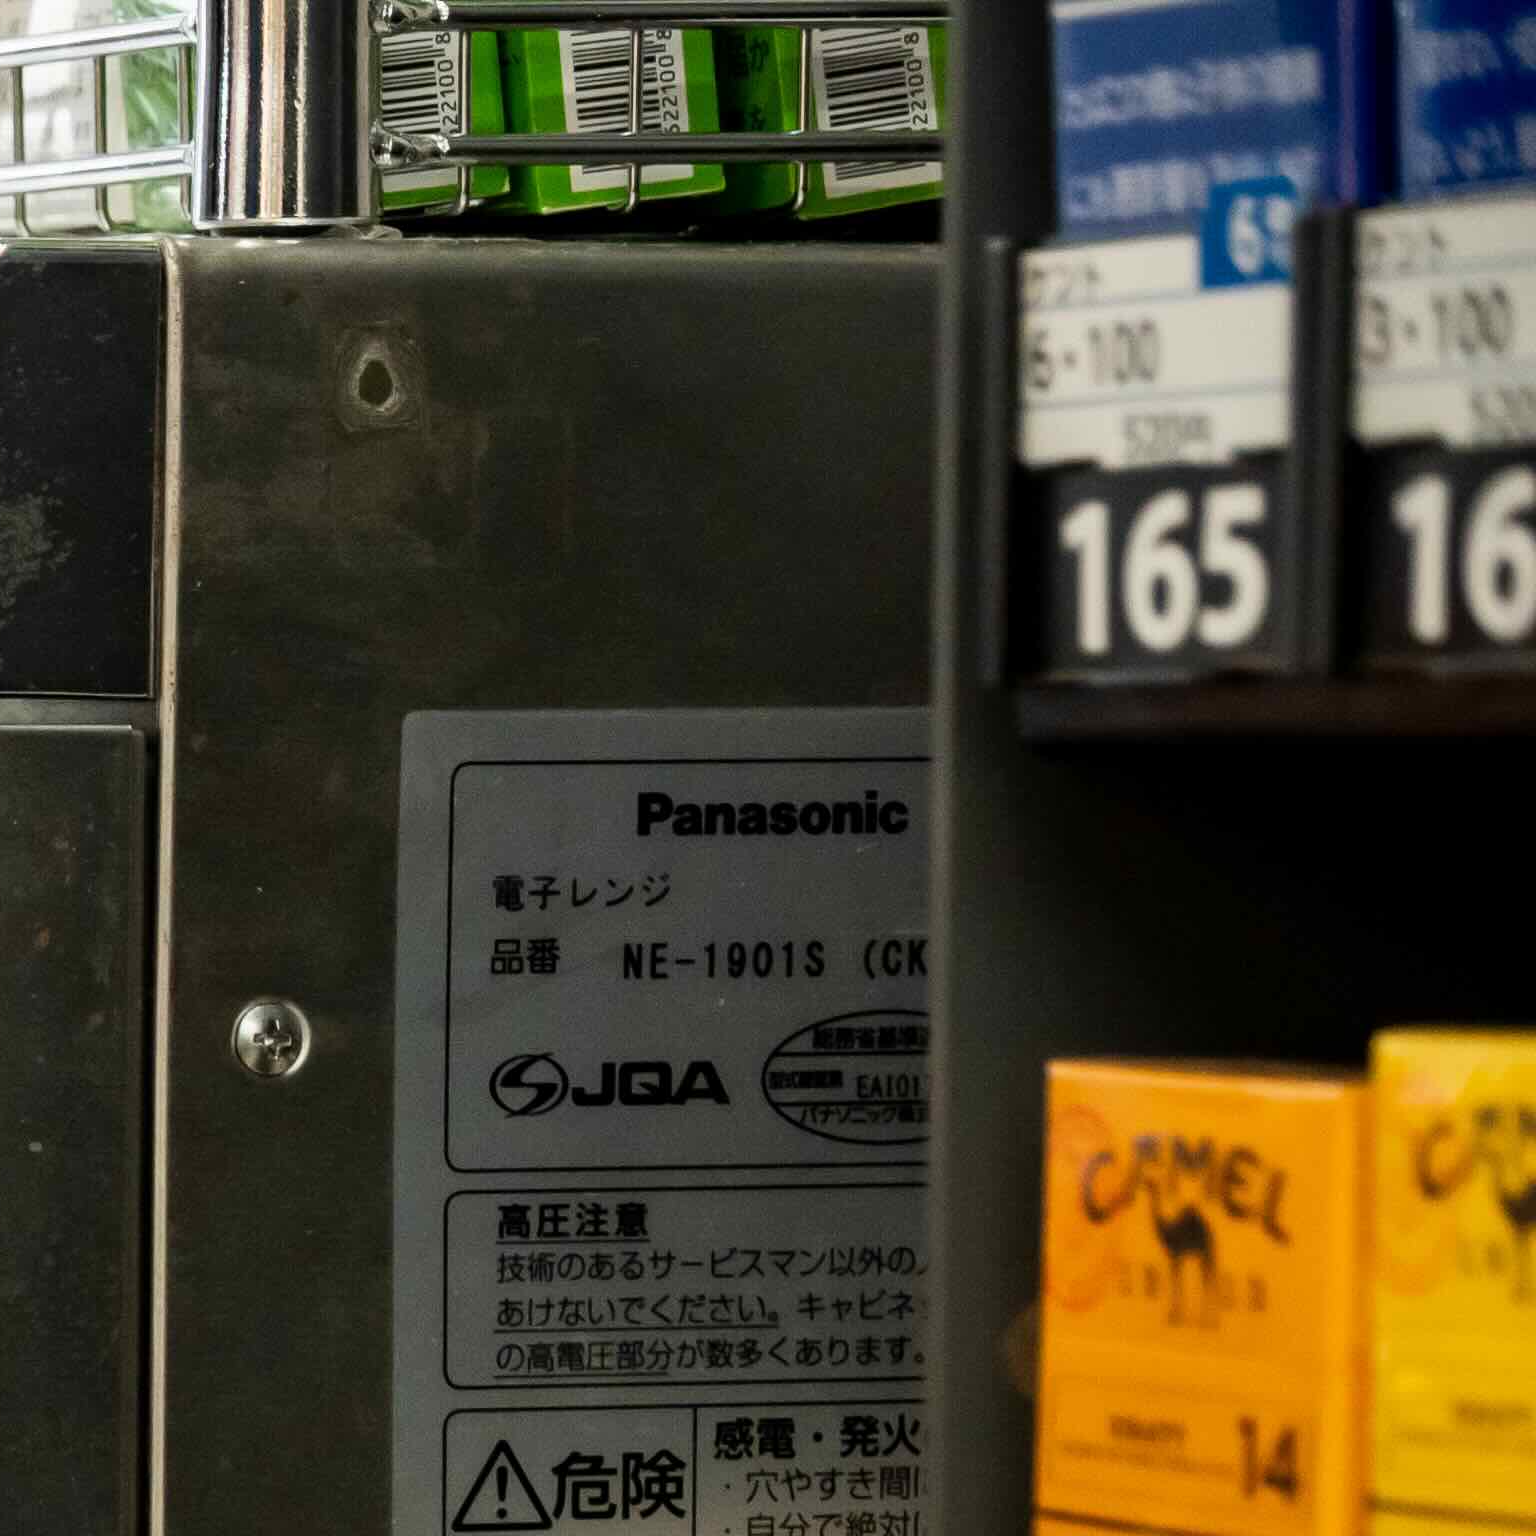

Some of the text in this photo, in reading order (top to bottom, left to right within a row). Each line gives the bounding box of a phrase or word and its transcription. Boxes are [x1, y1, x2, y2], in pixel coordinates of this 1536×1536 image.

[435, 33, 451, 45] 8
[904, 32, 928, 126] 22100 8
[1059, 482, 1270, 657] 165
[637, 791, 908, 835] Panasonic
[492, 874, 671, 910] 電子レンジ
[491, 939, 560, 975] 品番
[624, 941, 826, 980] NE-1901S
[572, 1062, 730, 1105] JQA
[1081, 1134, 1293, 1247] CAMEL
[498, 1203, 648, 1238] 高圧注意
[496, 1247, 926, 1283] 技術のあるサービスマン以外の
[496, 1335, 925, 1372] の高電圧部分が数多くあります。
[714, 1415, 921, 1460] 感電・発火
[1238, 1415, 1298, 1504] 14
[552, 1449, 687, 1520] 危険
